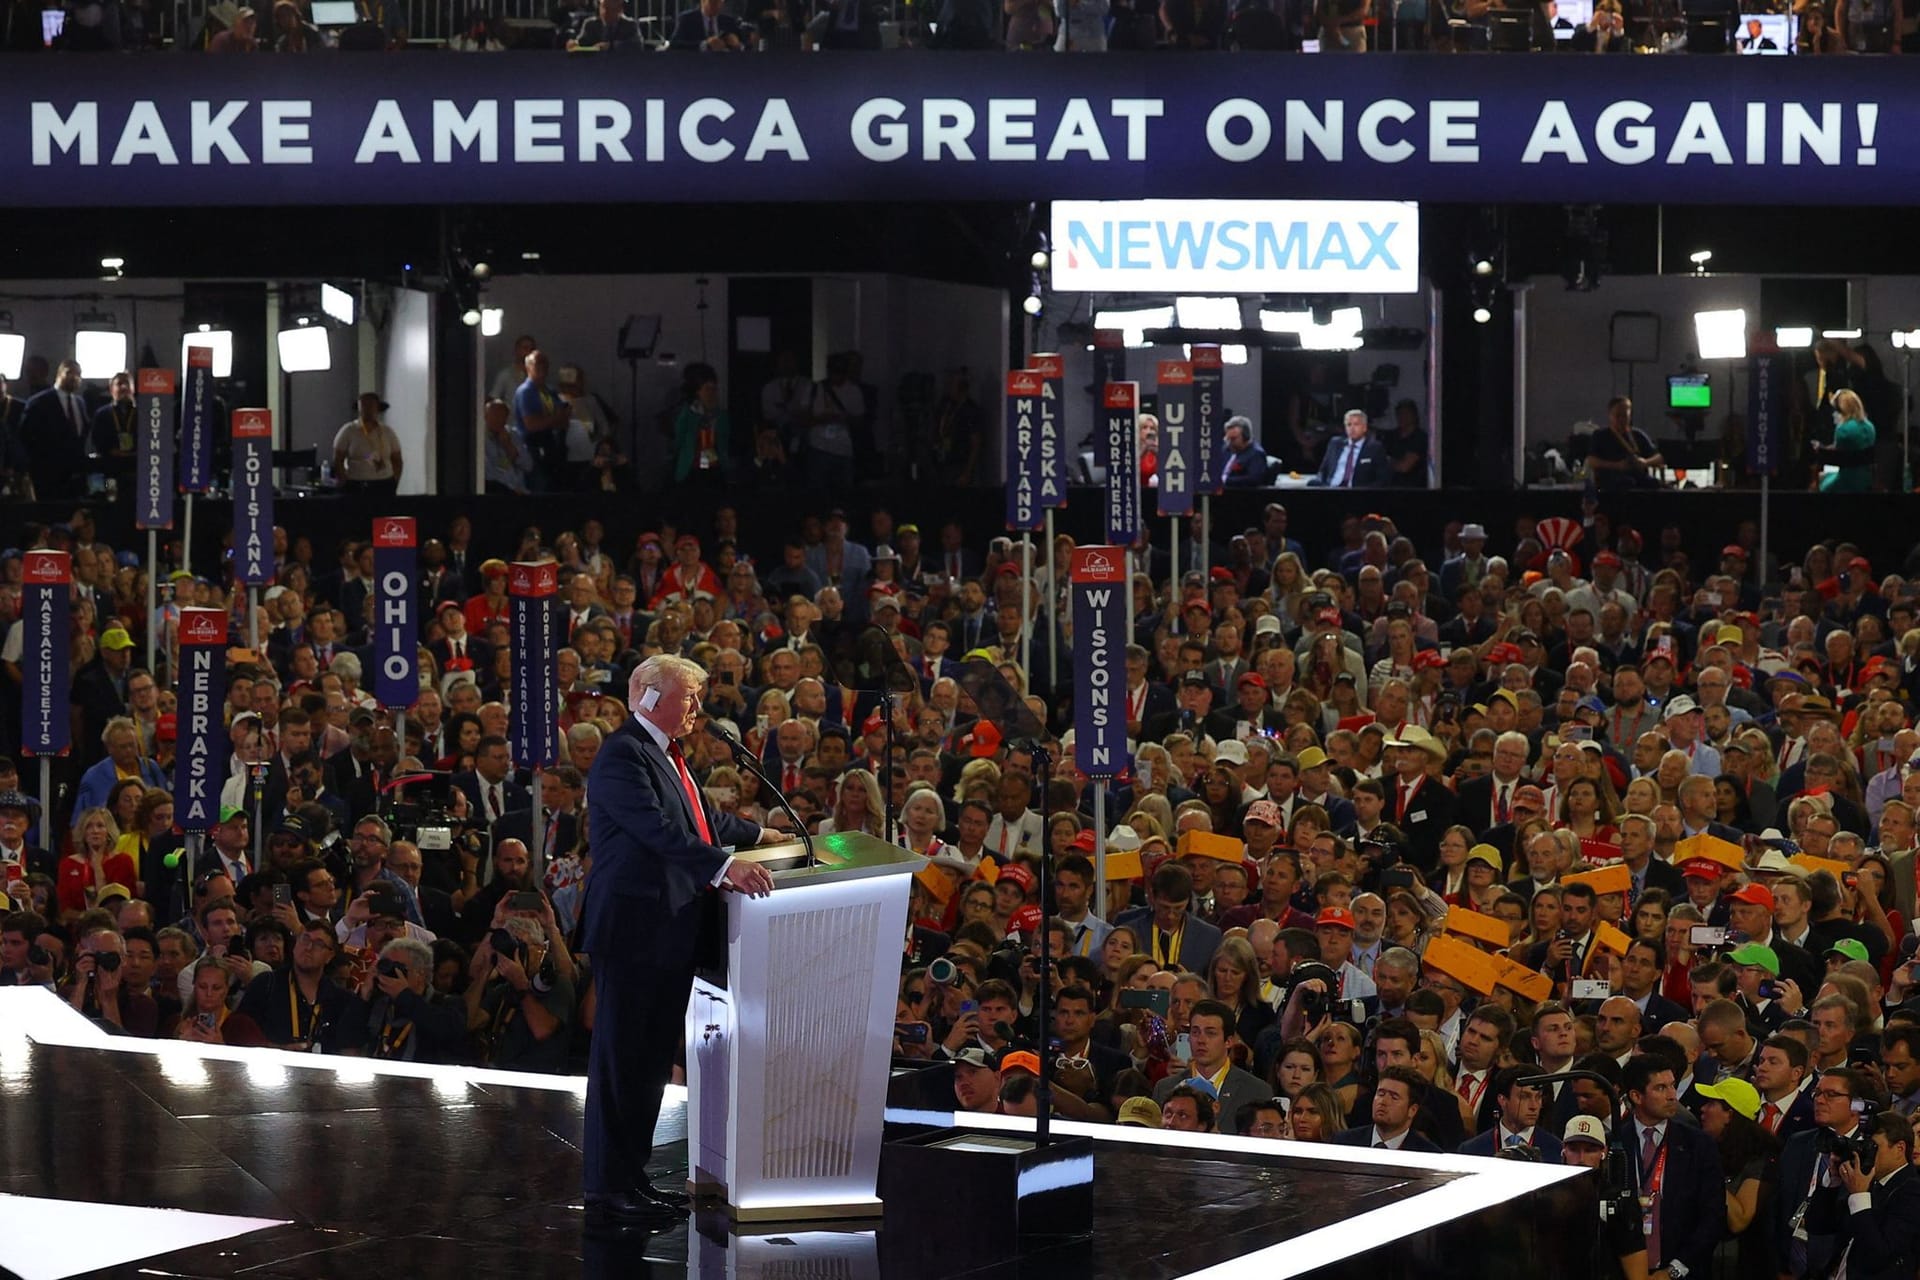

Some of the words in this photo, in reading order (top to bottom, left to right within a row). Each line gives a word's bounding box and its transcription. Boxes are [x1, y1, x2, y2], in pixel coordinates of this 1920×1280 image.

[32, 101, 313, 165] MAKE
[355, 98, 809, 164] AMERICA
[851, 98, 1164, 162] GREAT
[1205, 98, 1480, 163] ONCE
[1521, 101, 1879, 166] AGAIN!
[1068, 220, 1401, 270] NEWSMAX
[150, 397, 162, 450] SOUTH
[194, 369, 205, 411] SOUTH
[1199, 392, 1212, 483] COLUMBIA
[1757, 357, 1771, 465] WASHINGTON
[149, 455, 160, 519] DAKOTA
[191, 415, 202, 484] CAROLINA
[1017, 399, 1033, 522] MARYLAND
[1041, 382, 1058, 497] ALASKA
[1109, 418, 1122, 532] NORTHERN
[1165, 403, 1186, 493] UTAH
[245, 443, 262, 577] LOUISIANA
[40, 588, 53, 745] MASSACHUSETTS
[382, 571, 409, 680] OHIO
[518, 600, 528, 659] NORTH
[542, 599, 551, 659] NORTH
[519, 665, 530, 761] CAROLINA
[543, 665, 553, 760] CAROLINA
[1086, 589, 1112, 766] WISCONSIN
[187, 650, 211, 819] NEBRASKA
